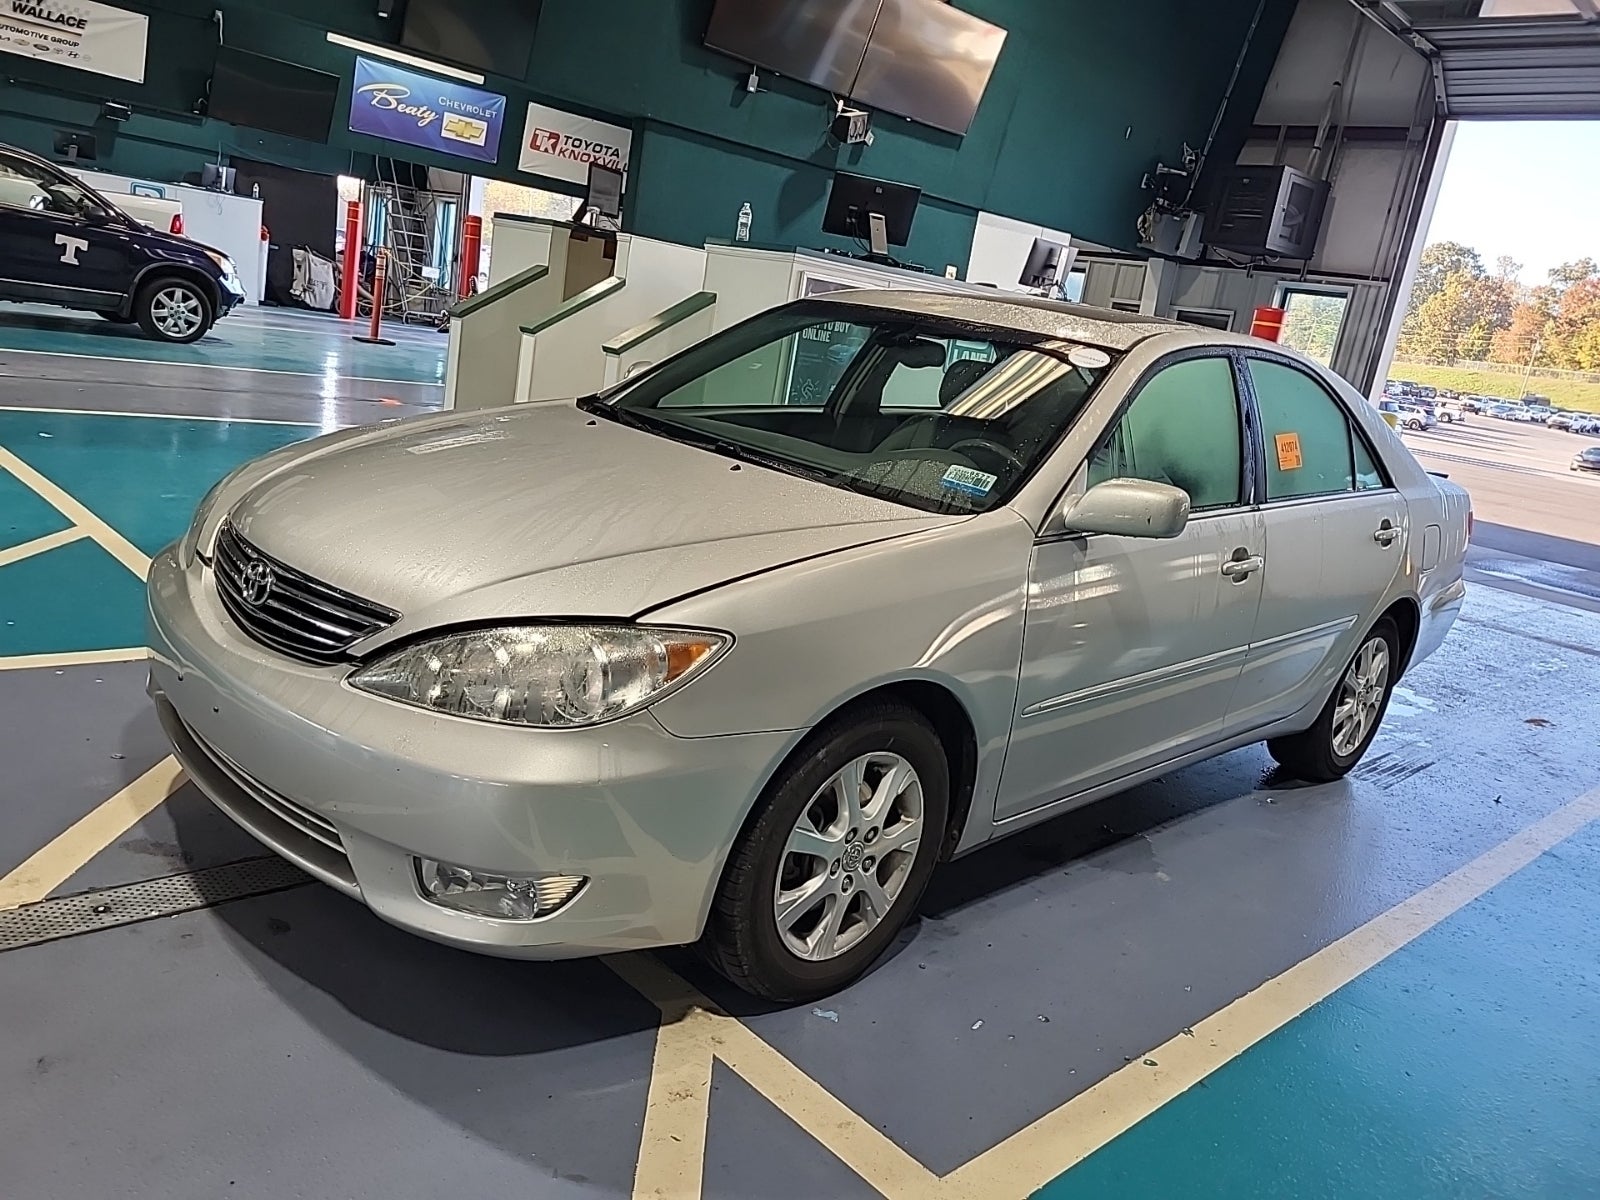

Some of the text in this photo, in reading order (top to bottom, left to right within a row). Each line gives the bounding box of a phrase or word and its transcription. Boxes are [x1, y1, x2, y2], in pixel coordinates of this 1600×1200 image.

[12, 1, 88, 29] WALLACE
[50, 36, 79, 47] GROUP
[357, 83, 439, 127] Beaty
[438, 96, 498, 119] CHEVROLET
[563, 135, 620, 159] TOYOTA
[55, 233, 89, 266] T
[802, 327, 832, 343] ONLINE
[834, 321, 851, 333] BUY
